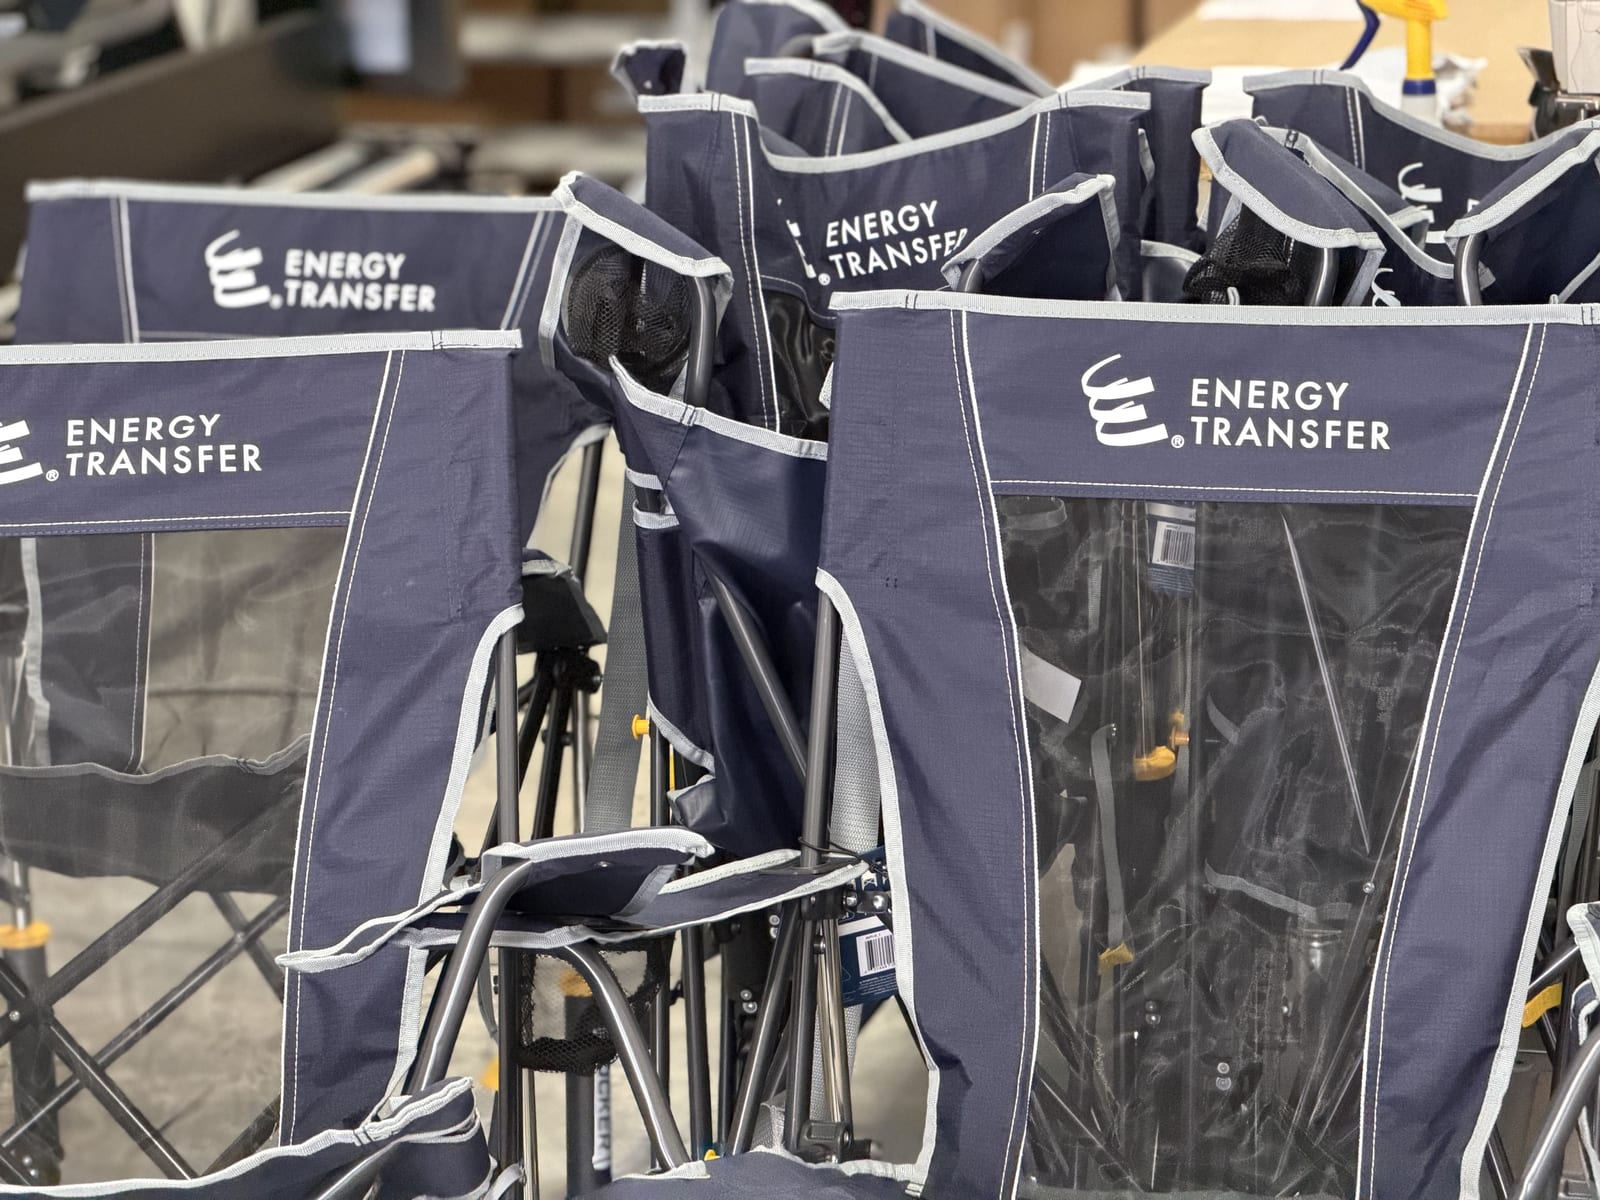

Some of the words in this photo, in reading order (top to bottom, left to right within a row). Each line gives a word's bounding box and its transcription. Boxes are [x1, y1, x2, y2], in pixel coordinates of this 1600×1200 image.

[825, 200, 938, 248] ENERGY
[284, 248, 406, 280] ENERGY
[283, 279, 436, 312] TRANSFER
[1191, 377, 1349, 411] ENERGY
[66, 413, 221, 447] ENERGY
[1190, 416, 1391, 450] TRANSFER
[65, 443, 262, 477] TRANSFER
